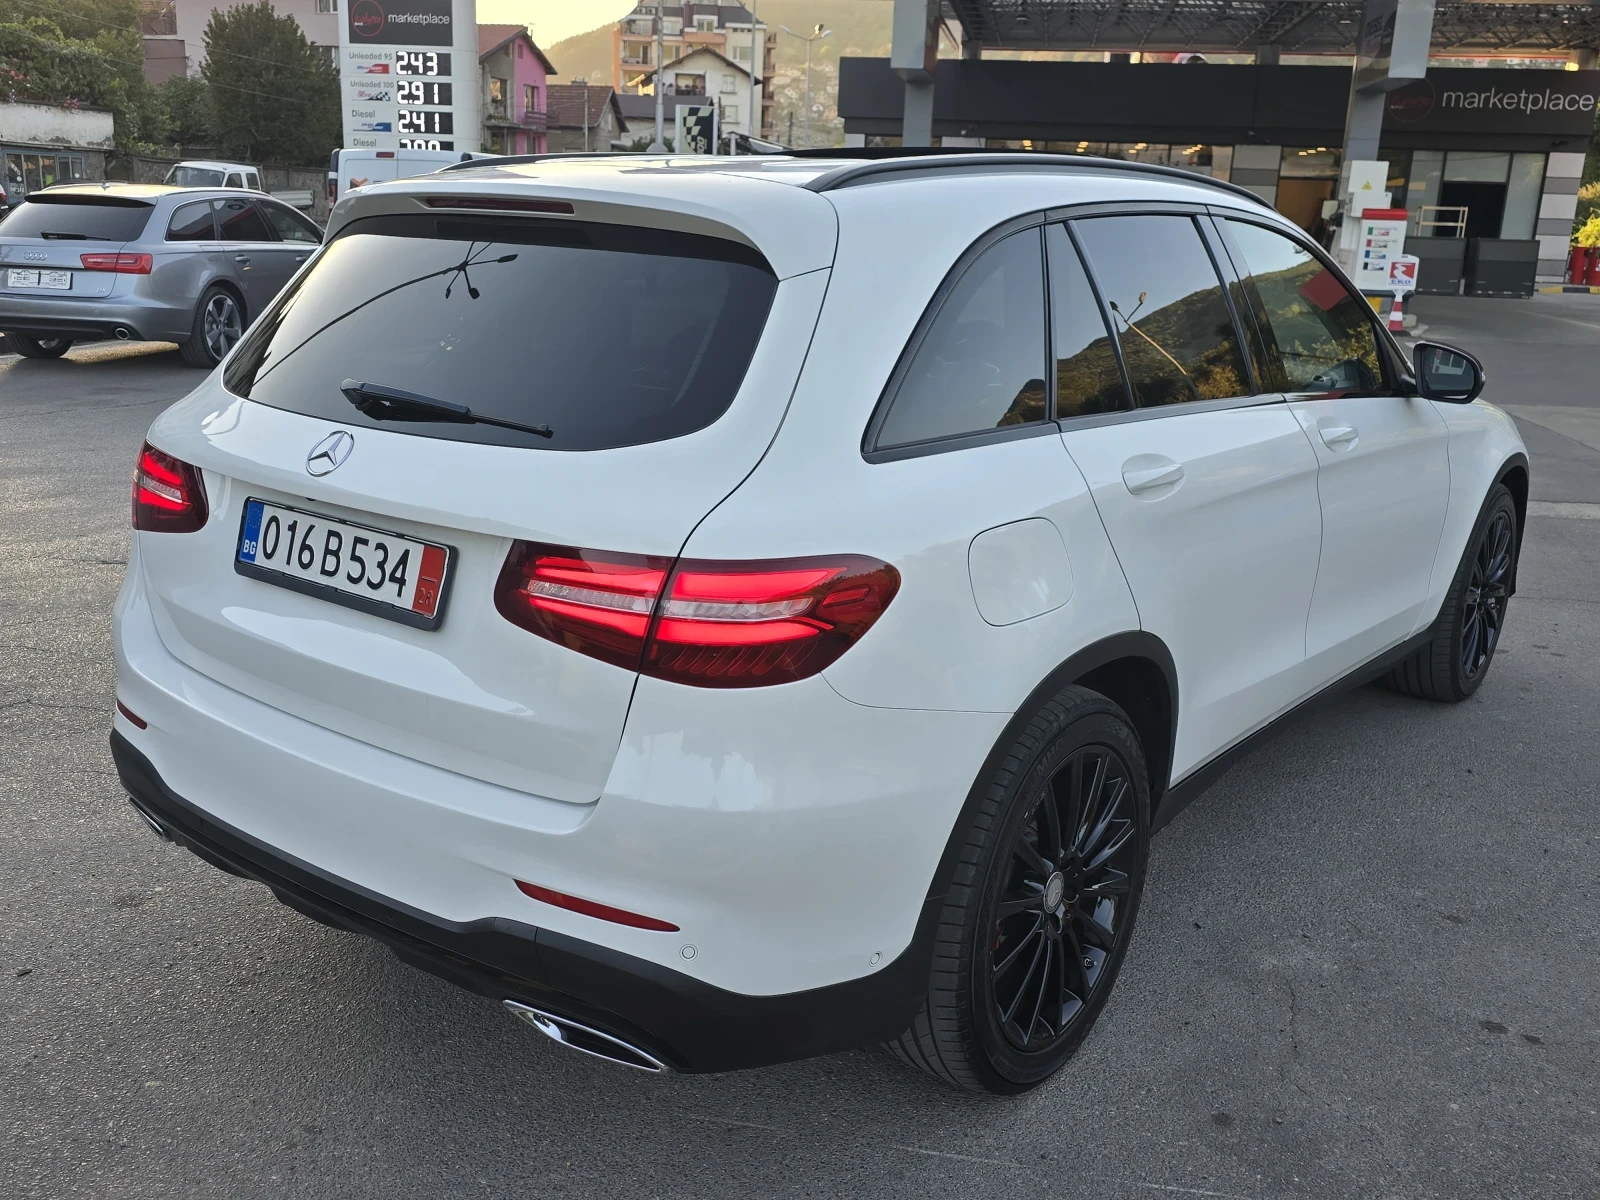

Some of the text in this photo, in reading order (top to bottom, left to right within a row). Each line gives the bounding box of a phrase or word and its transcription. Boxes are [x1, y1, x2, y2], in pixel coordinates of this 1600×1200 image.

[388, 13, 450, 26] marketplace
[349, 52, 382, 60] Unleaded
[396, 51, 438, 76] 2.43
[397, 81, 439, 105] 2.91
[1442, 87, 1595, 114] marketplace
[352, 109, 376, 118] Diesel
[398, 109, 440, 133] 2.41
[353, 138, 377, 147] Diesel
[243, 515, 411, 597] BG 016B534
